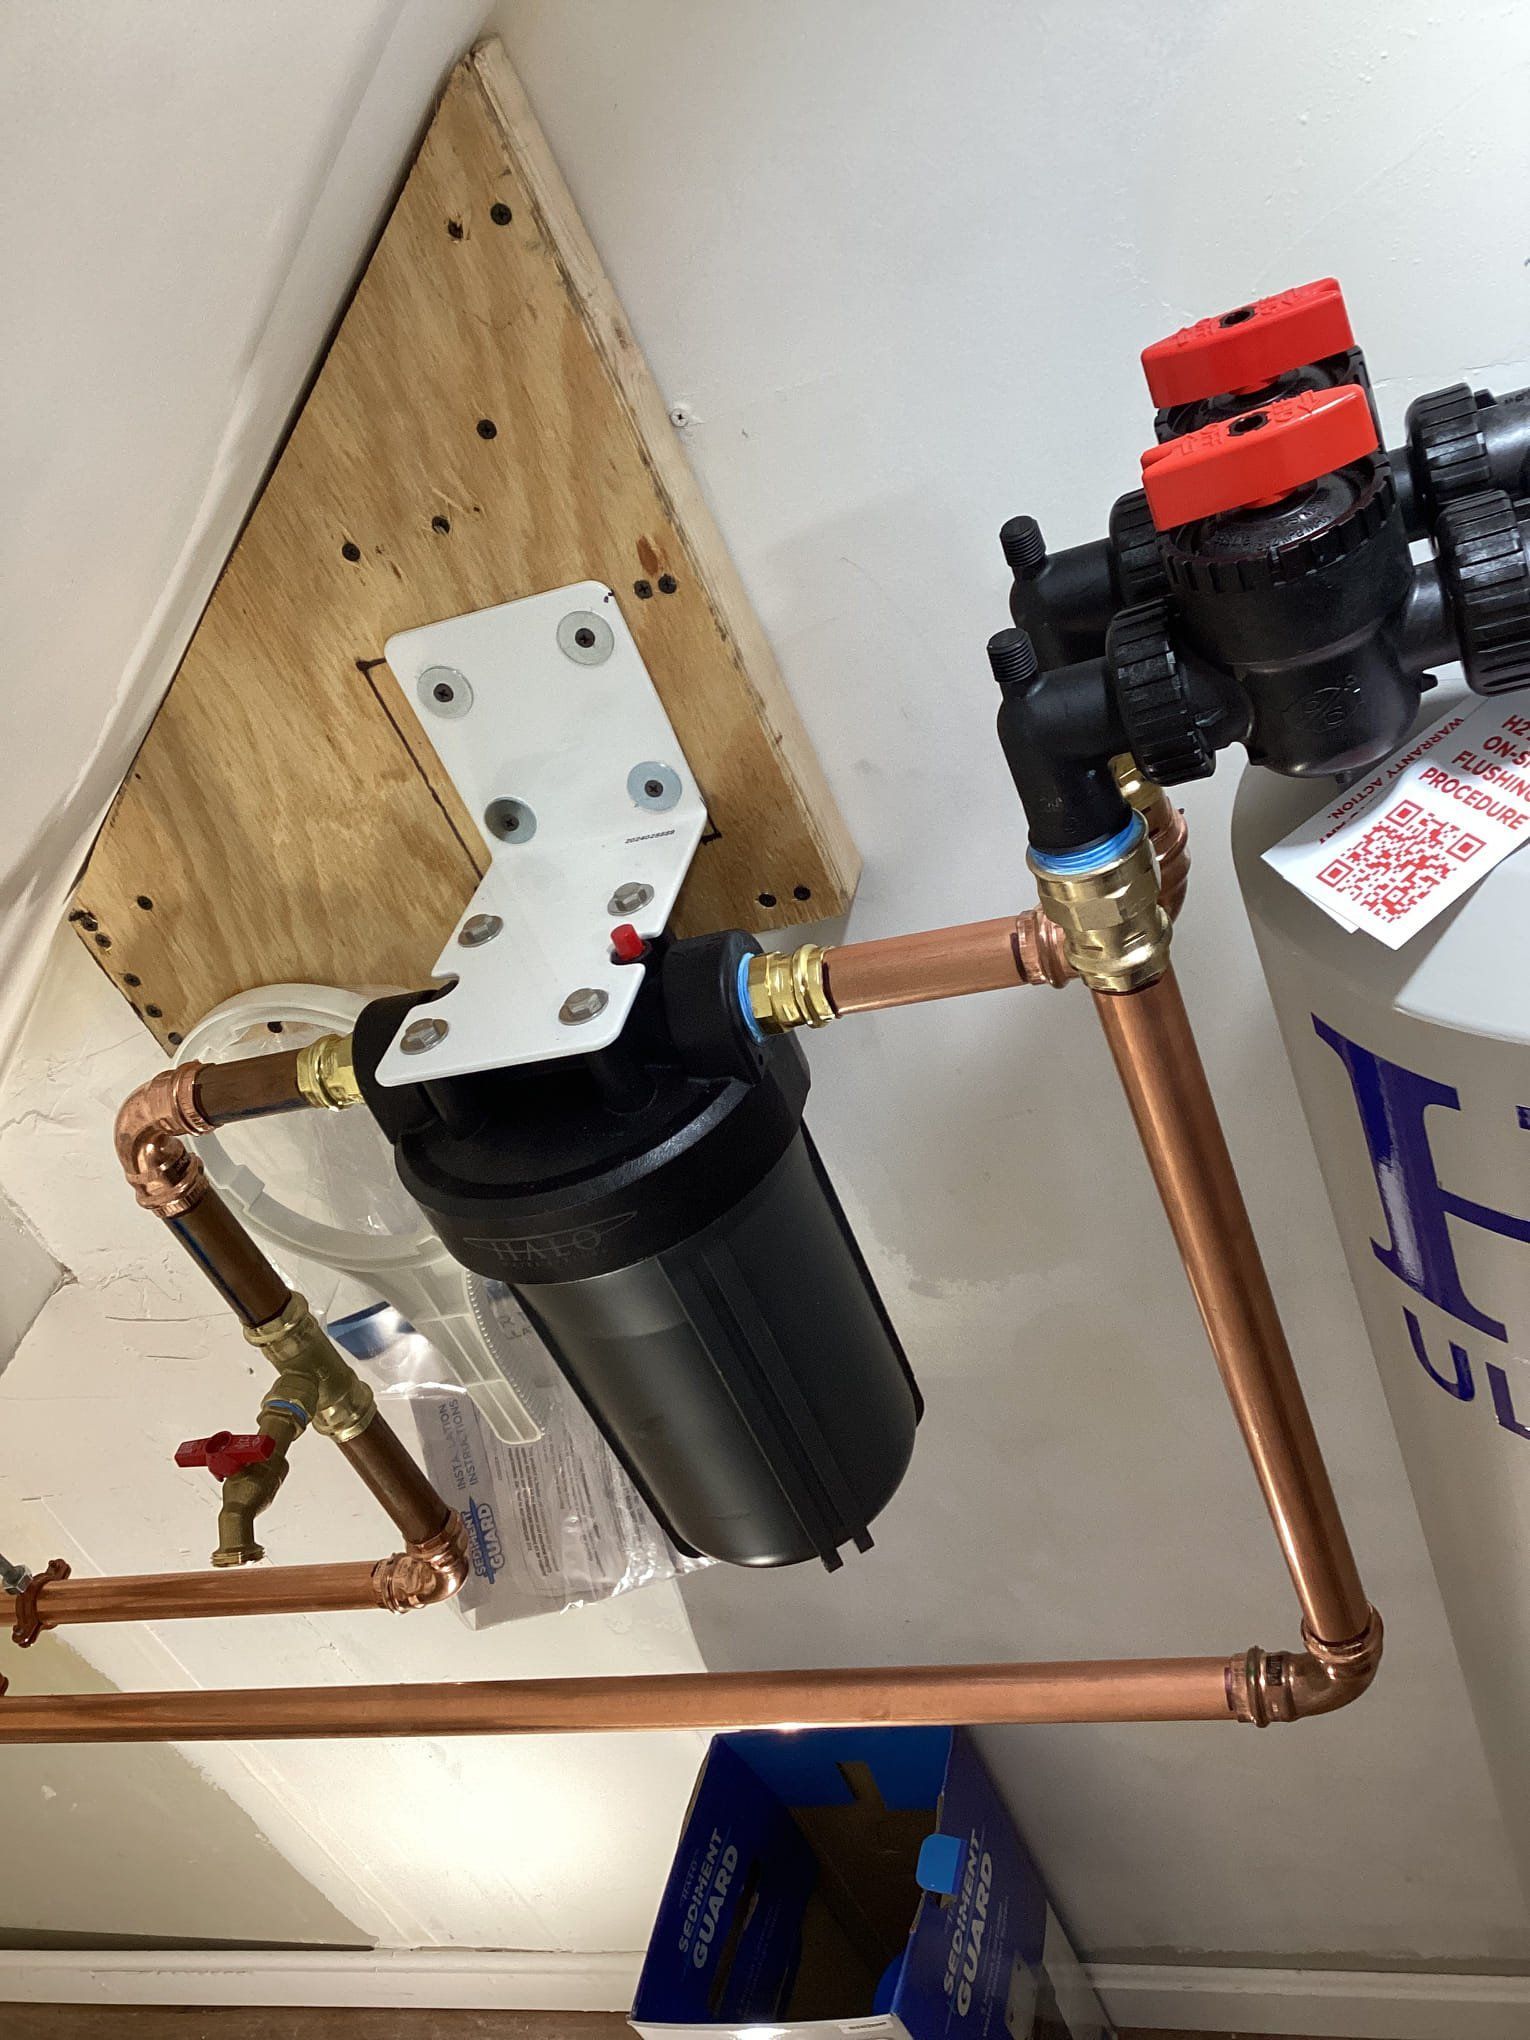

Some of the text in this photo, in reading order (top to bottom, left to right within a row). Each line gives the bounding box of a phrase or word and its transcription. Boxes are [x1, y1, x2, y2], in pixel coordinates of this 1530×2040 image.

[1327, 717, 1465, 820] WARRANTY ACTION.
[1501, 714, 1530, 737] H2
[1418, 766, 1529, 830] PROCEDURE
[490, 1229, 600, 1262] HALO
[438, 1403, 466, 1490] INSTALATION
[477, 1503, 505, 1571] GUARD
[679, 1827, 722, 1952] SEDIMENT
[693, 1845, 738, 1969] GUARD
[943, 1828, 979, 1996] SEDIMENT
[957, 1852, 993, 2017] GUARD
